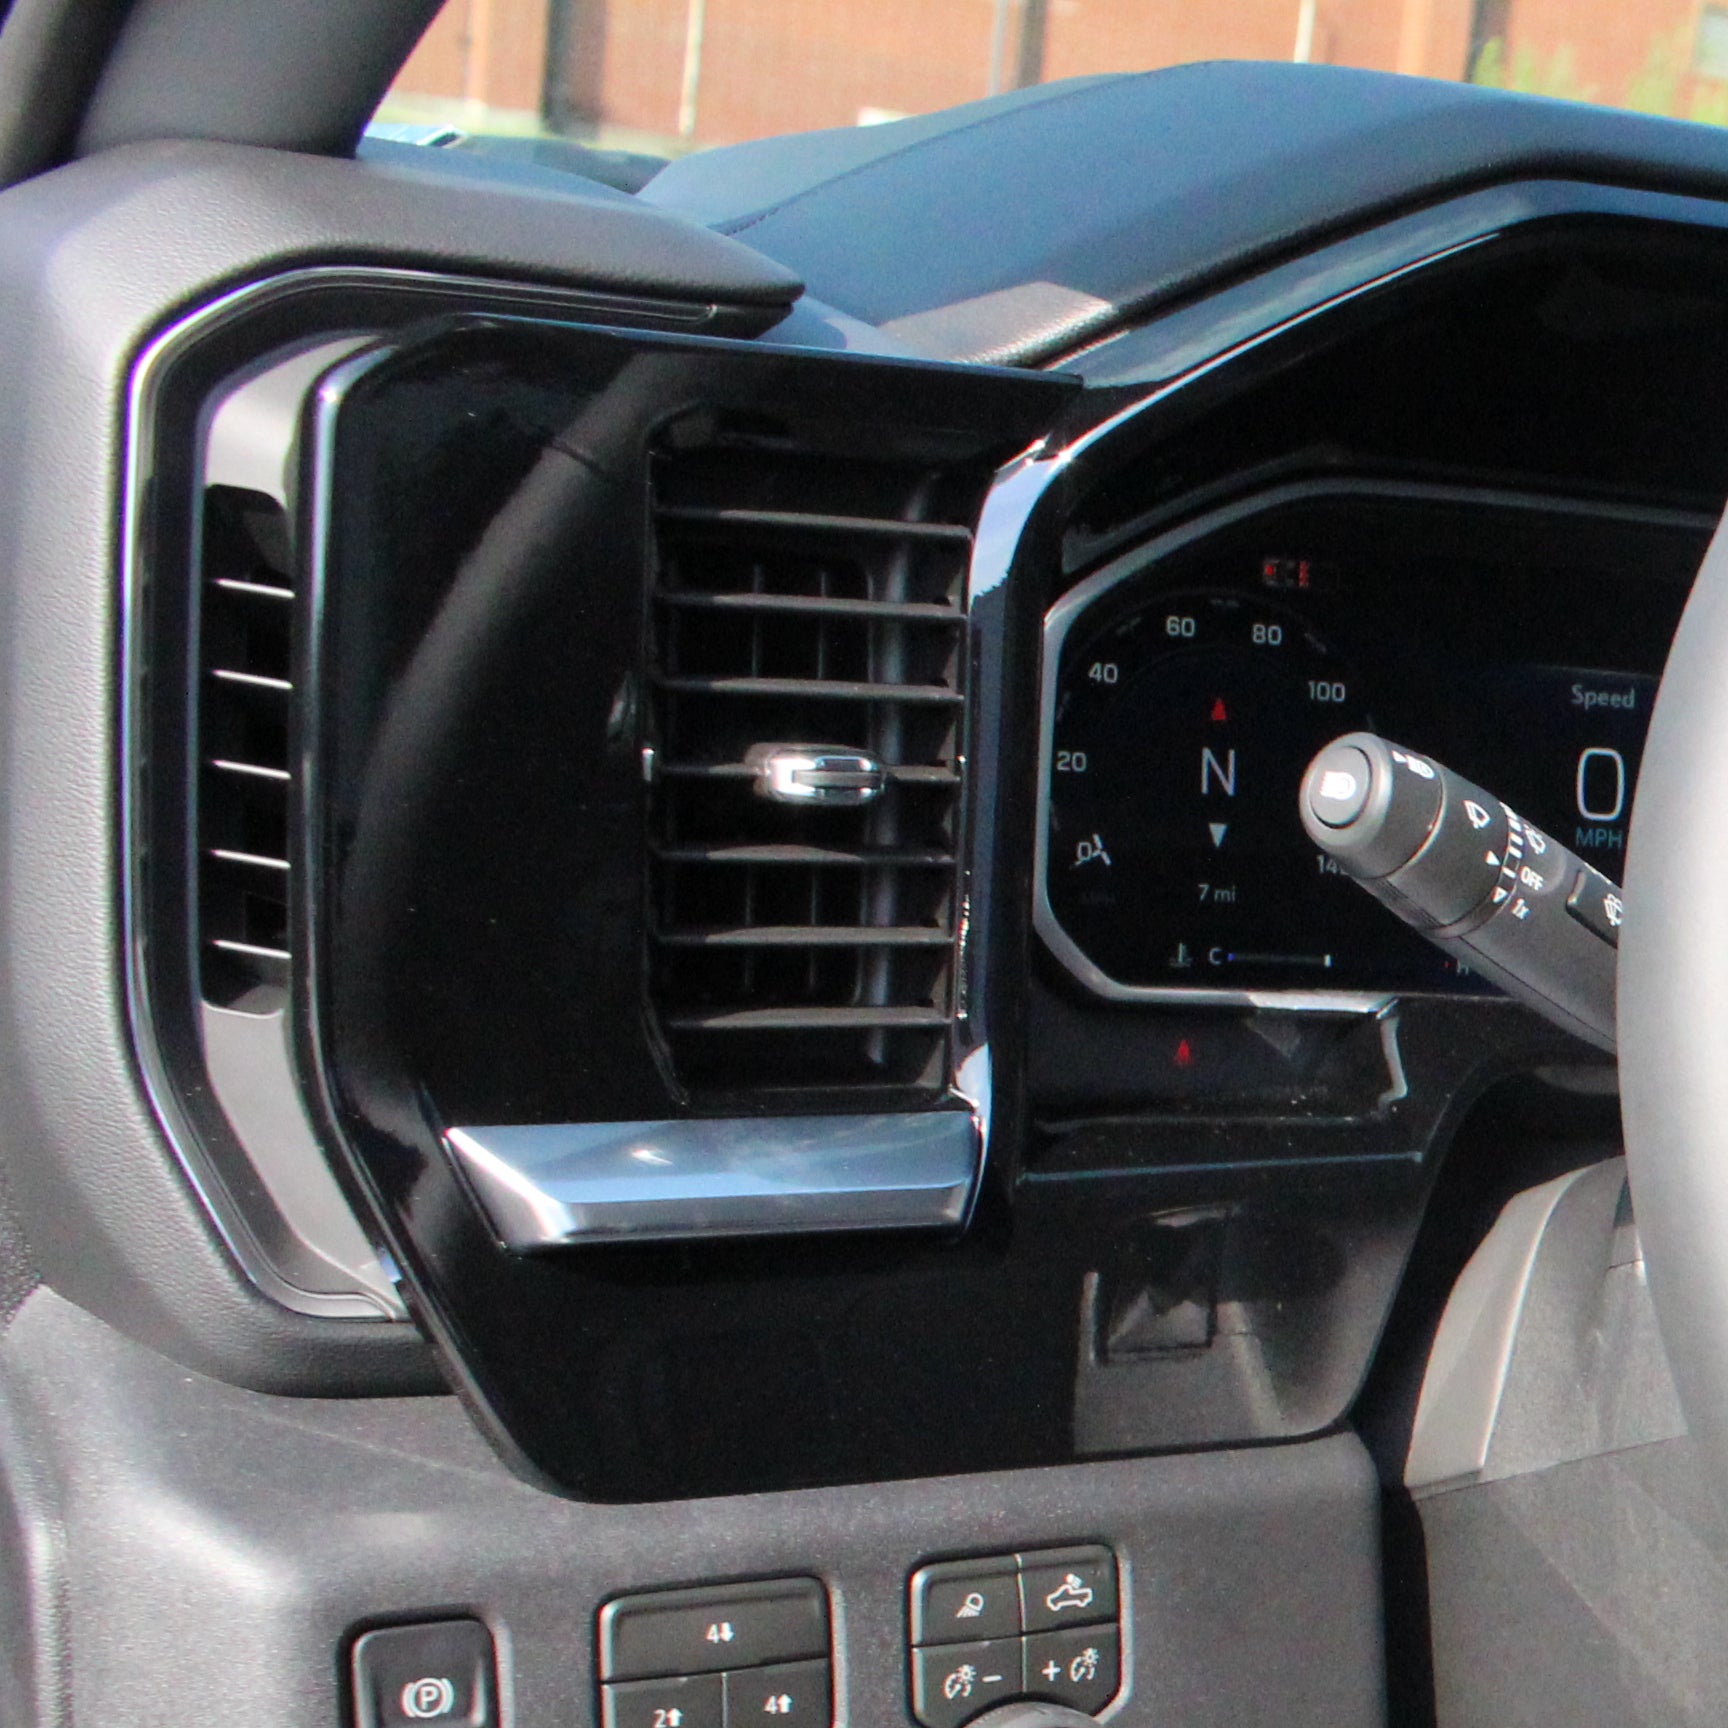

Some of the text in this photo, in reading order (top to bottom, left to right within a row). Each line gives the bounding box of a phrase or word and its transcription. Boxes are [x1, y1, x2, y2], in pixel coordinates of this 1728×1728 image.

[1165, 616, 1196, 637] 60
[1251, 624, 1282, 646] 80
[1088, 662, 1118, 683] 40
[1307, 680, 1346, 702] 100
[1570, 683, 1636, 710] Speed
[1056, 752, 1087, 773] 20
[1201, 746, 1237, 797] N
[1577, 748, 1625, 821] 0
[1575, 827, 1623, 848] MPH
[1316, 854, 1350, 876] 14
[1520, 865, 1545, 891] OFF
[1198, 883, 1236, 902] 7 mi
[1511, 897, 1531, 919] 1x
[1208, 947, 1223, 965] C
